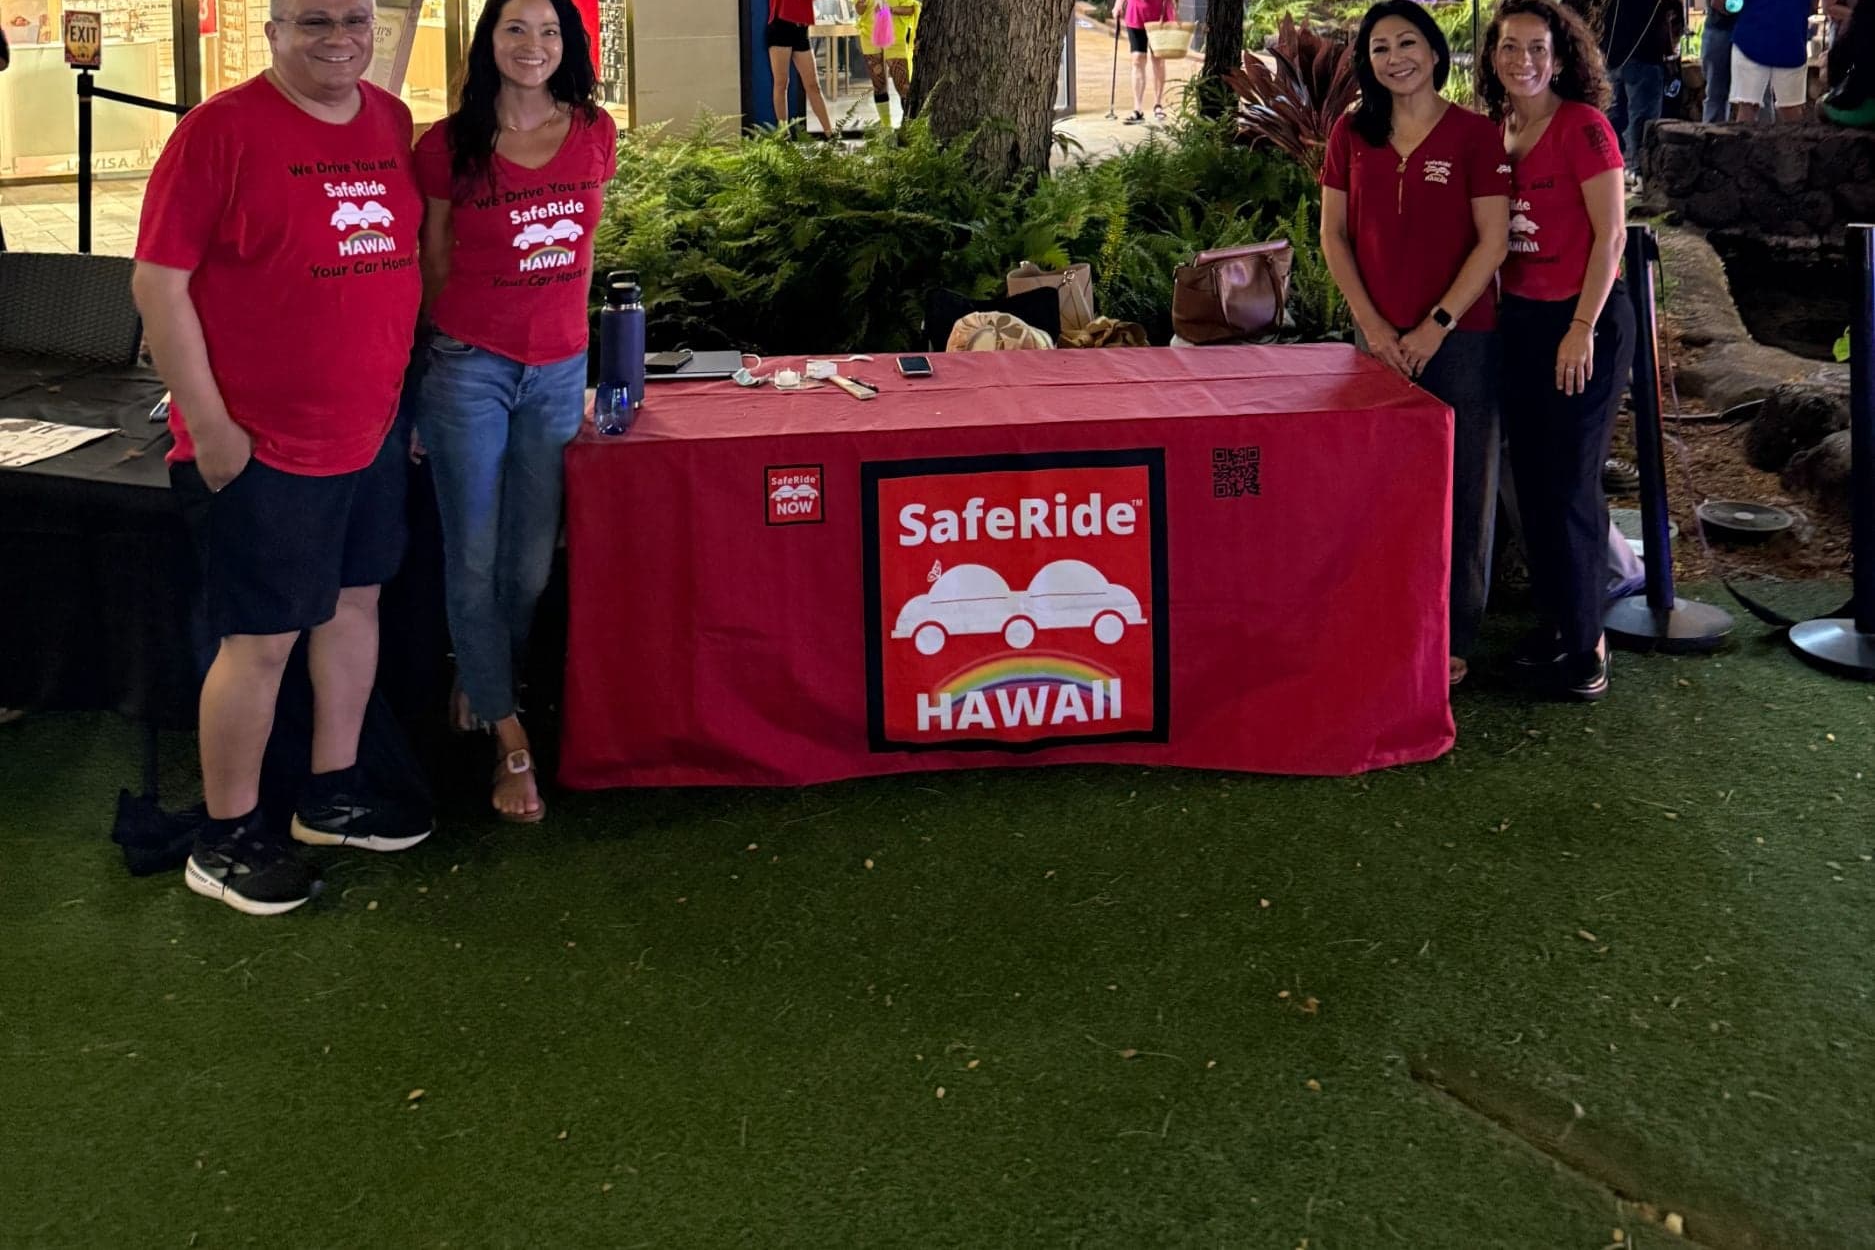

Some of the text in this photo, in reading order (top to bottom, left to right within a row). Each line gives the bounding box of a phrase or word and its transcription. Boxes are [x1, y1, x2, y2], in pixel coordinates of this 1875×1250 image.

[70, 25, 98, 43] EXIT
[316, 161, 350, 174] Drive
[353, 158, 376, 172] You
[324, 180, 387, 198] SafeRide
[504, 187, 545, 204] Drive
[547, 182, 576, 194] You
[509, 199, 585, 225] SafeRide
[338, 237, 396, 257] HAWAII
[310, 264, 348, 279] Your
[353, 259, 379, 275] Car
[519, 250, 576, 272] HAWAII
[527, 273, 554, 287] Car
[771, 475, 816, 486] SafeRide
[776, 501, 813, 515] NOW
[899, 493, 1136, 546] SafeRide
[916, 678, 1123, 731] HAWAII
